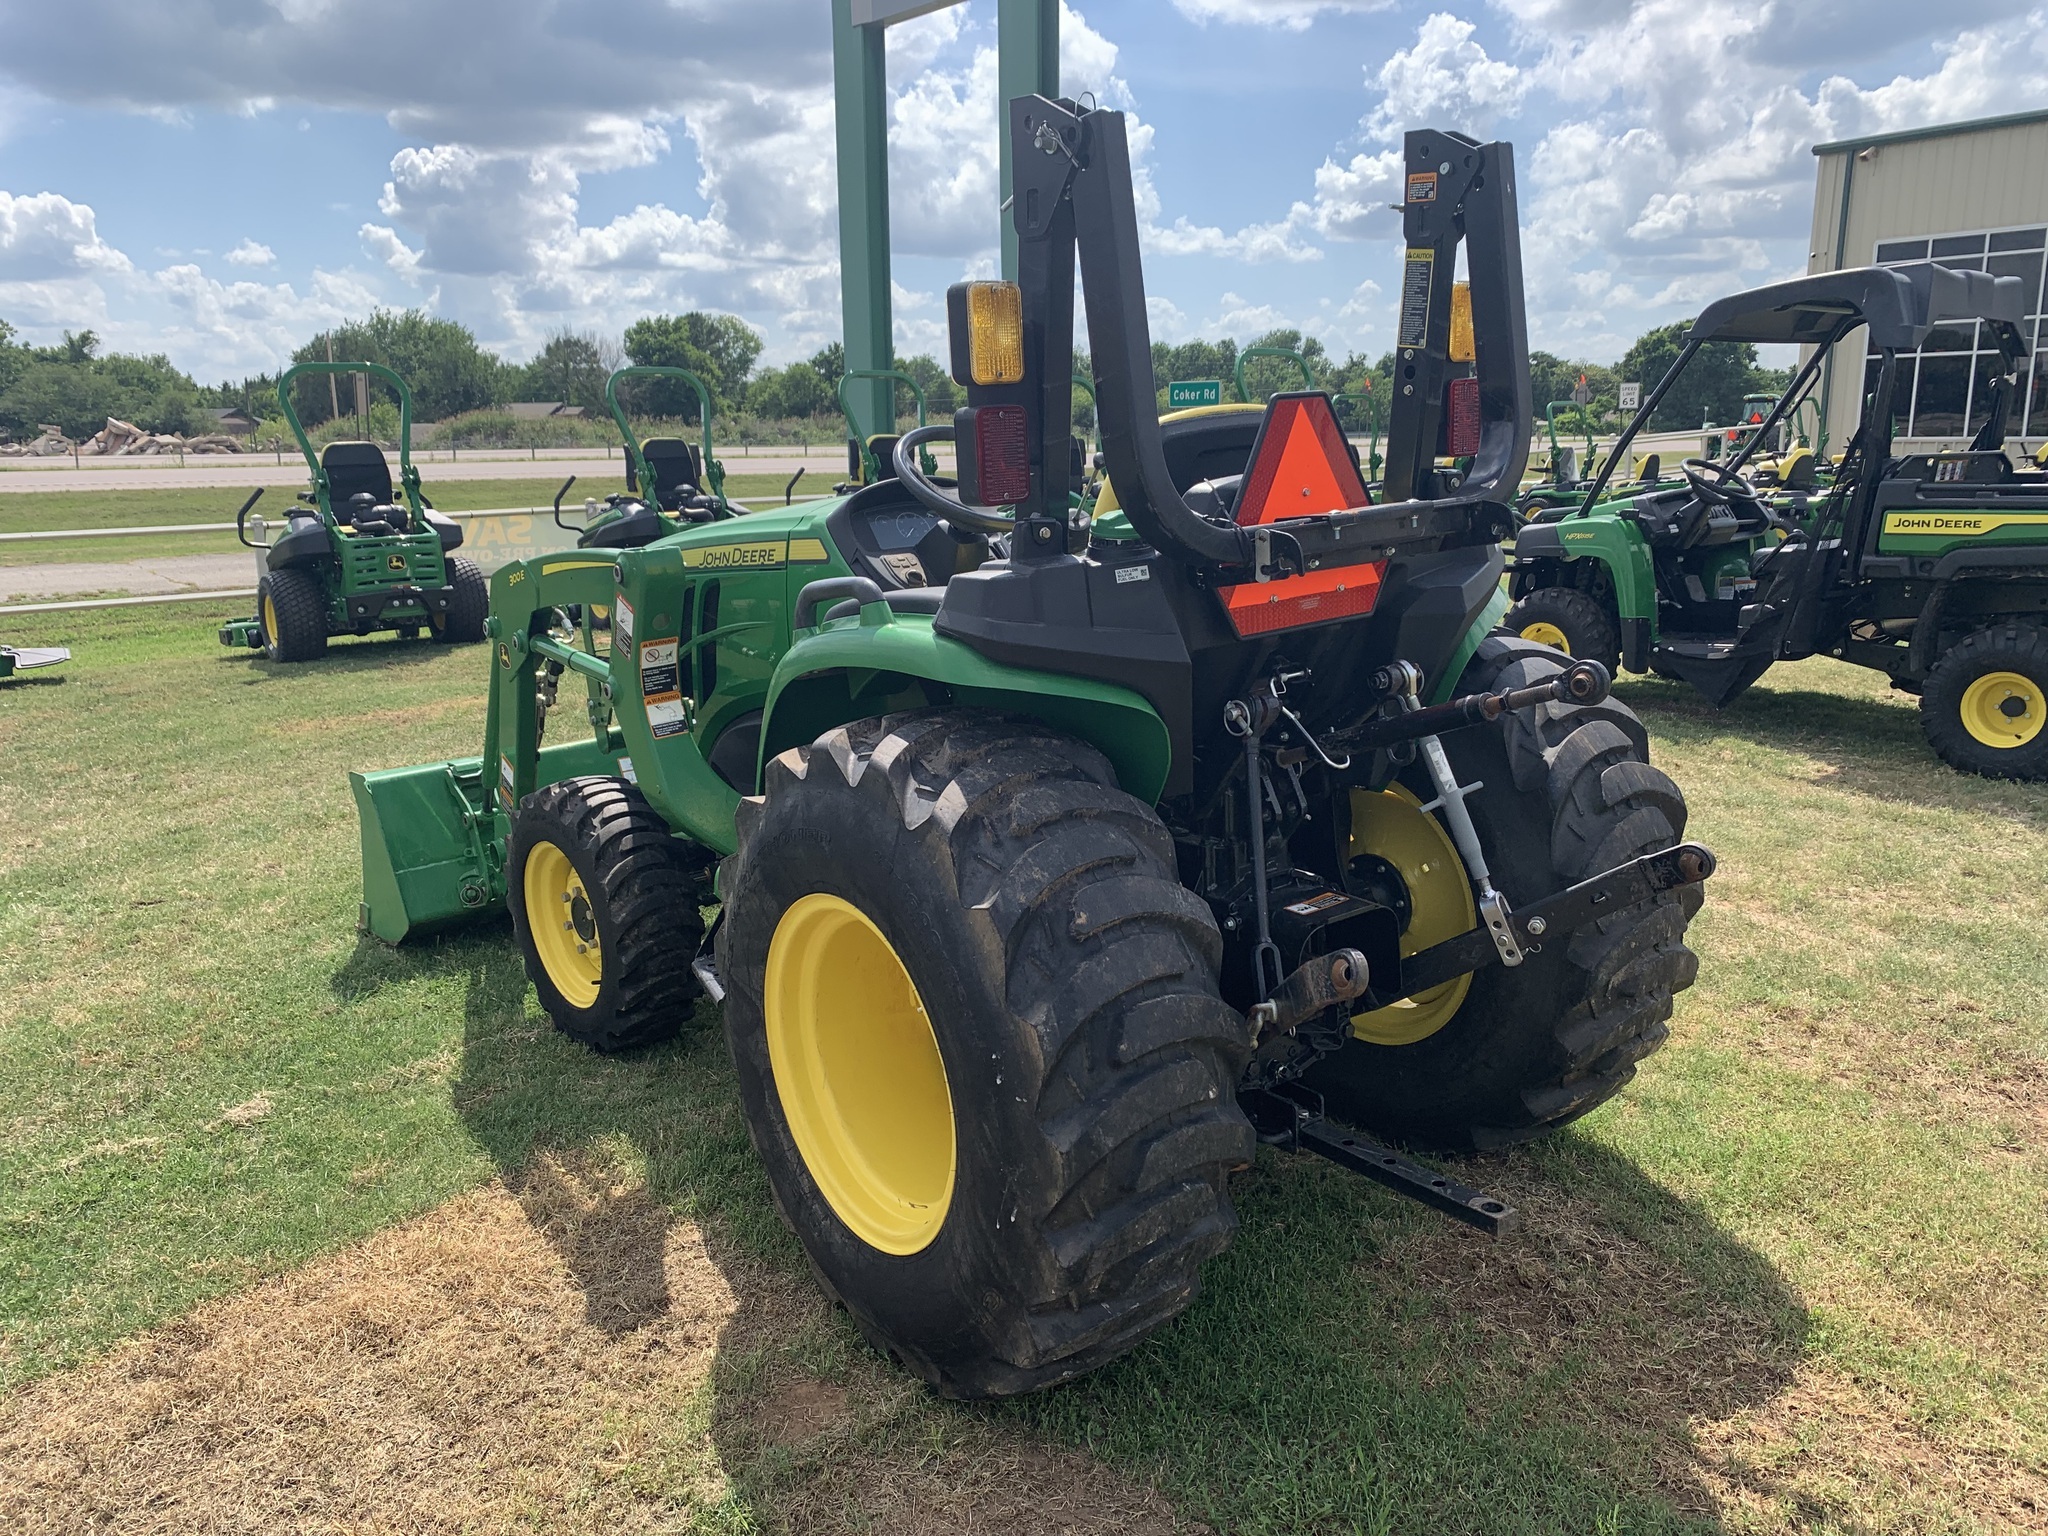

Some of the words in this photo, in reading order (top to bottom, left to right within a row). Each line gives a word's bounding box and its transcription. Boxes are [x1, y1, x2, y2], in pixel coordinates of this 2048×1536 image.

[1173, 388, 1200, 400] Coker
[1203, 388, 1216, 400] Rd
[1622, 397, 1635, 406] 65
[1893, 518, 1931, 528] JOHN
[1934, 518, 1983, 529] DEERE
[698, 550, 731, 566] JOHN
[731, 548, 776, 564] DEERE
[649, 637, 677, 647] WARNING
[651, 694, 680, 704] WARNING
